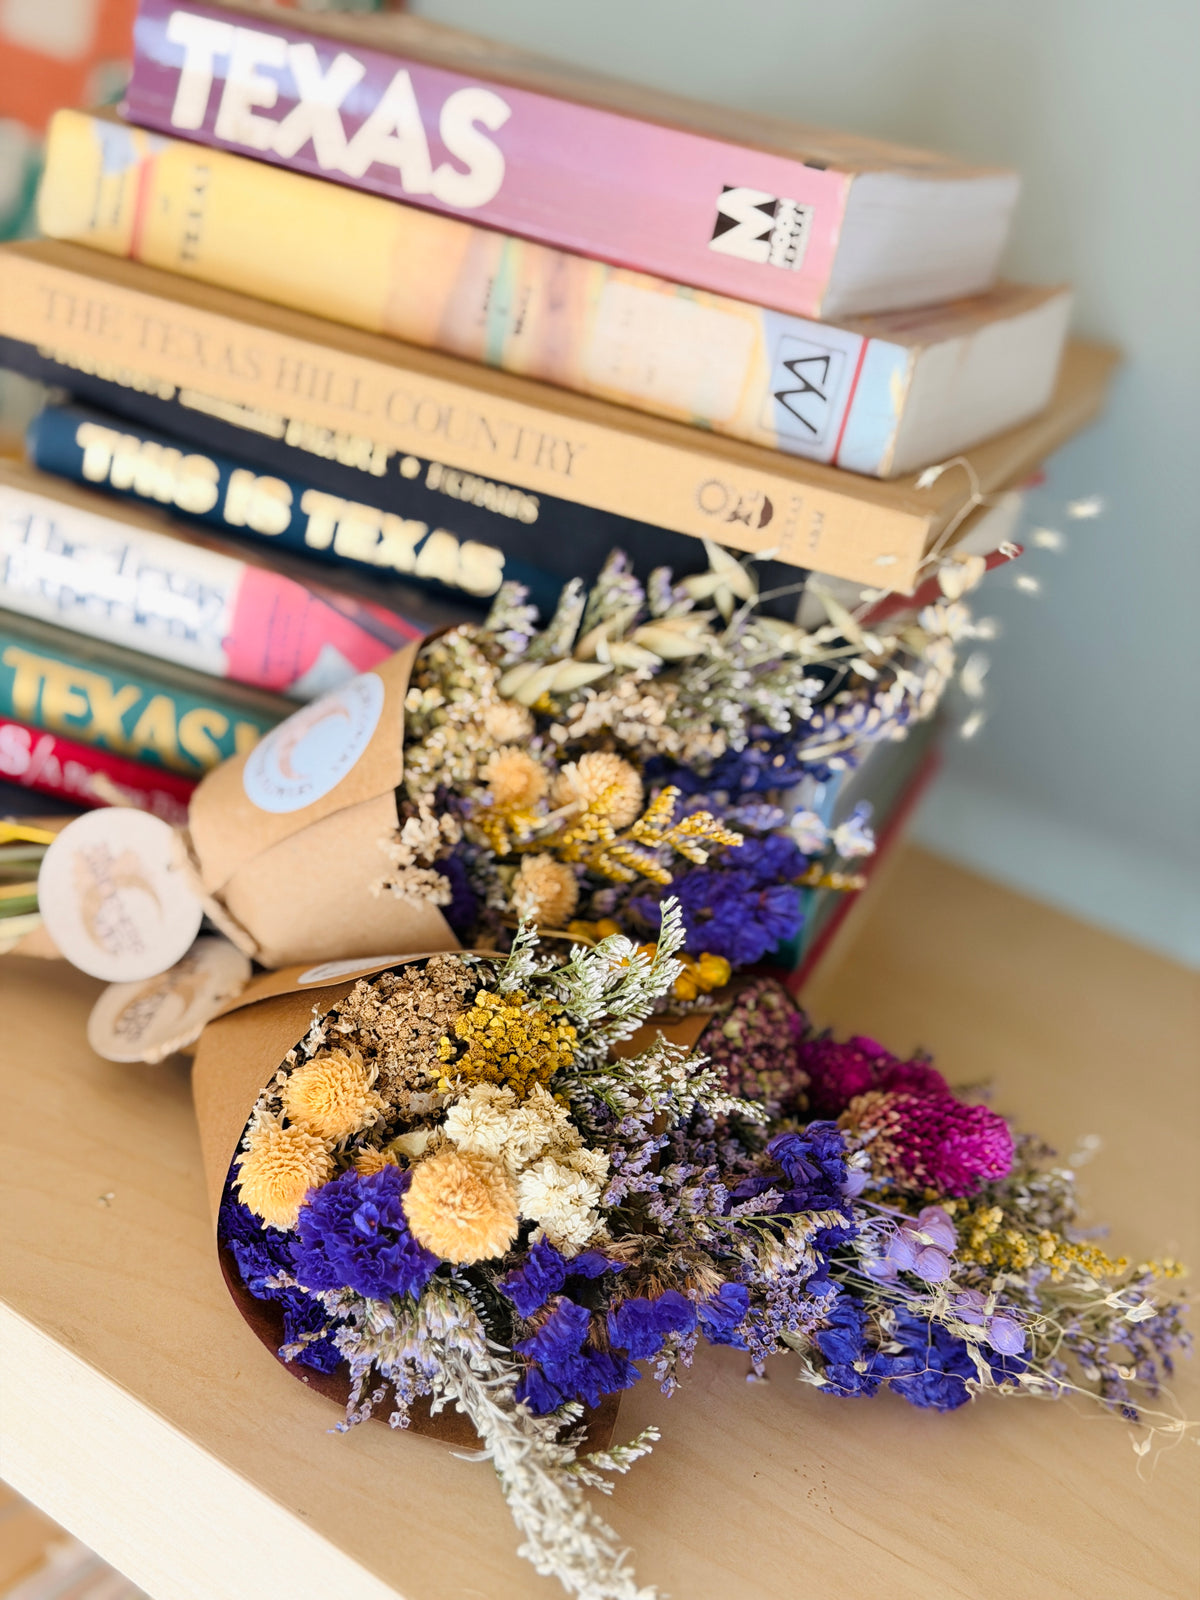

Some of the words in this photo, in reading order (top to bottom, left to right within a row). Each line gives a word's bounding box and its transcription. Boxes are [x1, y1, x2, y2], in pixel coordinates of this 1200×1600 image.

[166, 10, 511, 209] TEXAS
[136, 306, 262, 386] TEXAS
[274, 357, 375, 414] HILL
[387, 385, 588, 478] COUNTRY
[223, 468, 294, 536] IS
[301, 489, 506, 597] TEXAS
[4, 648, 229, 772] TEXAS
